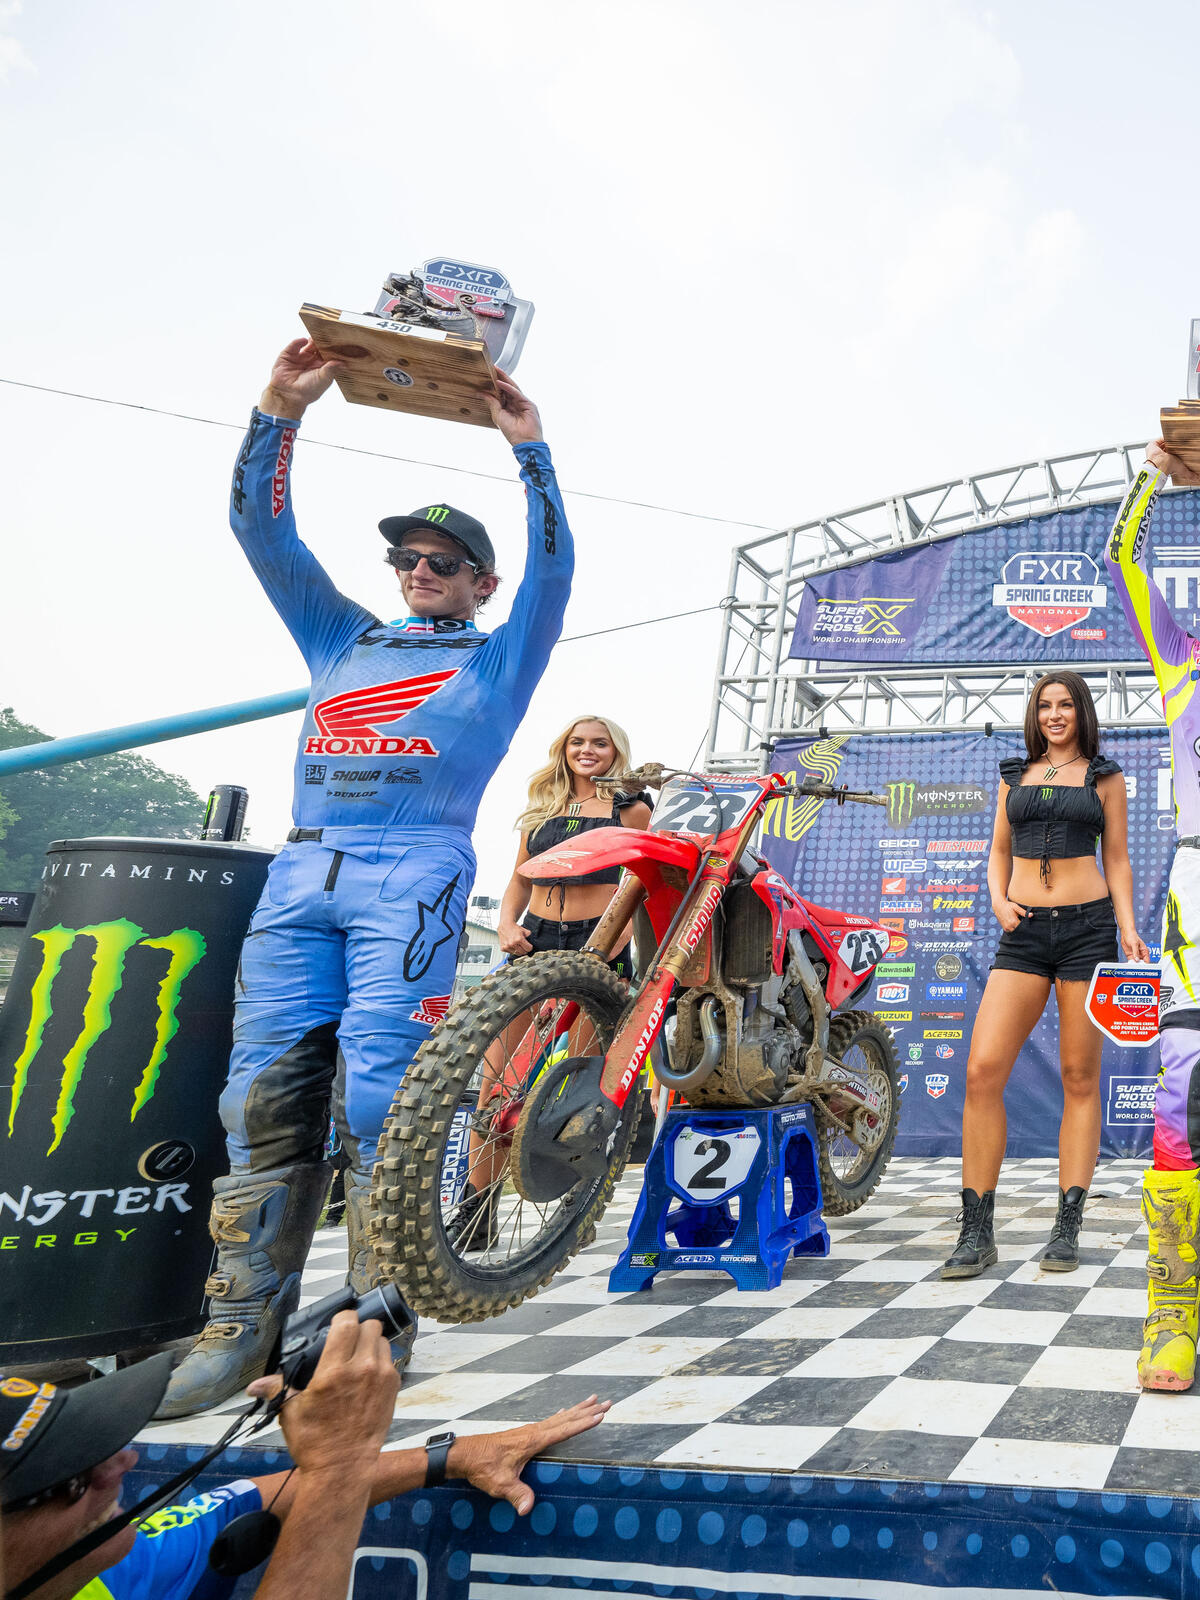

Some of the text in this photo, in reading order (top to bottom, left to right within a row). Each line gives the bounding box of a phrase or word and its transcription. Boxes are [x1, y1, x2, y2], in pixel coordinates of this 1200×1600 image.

[440, 263, 493, 284] FXR
[425, 275, 499, 297] SPRING CREEK
[376, 320, 412, 333] 450
[272, 428, 298, 518] HONDA
[1018, 559, 1083, 581] FXR
[1006, 588, 1094, 602] SPRING CREEK
[816, 605, 866, 615] SUPER
[1017, 607, 1081, 615] NATIONAL
[817, 614, 863, 624] MOTO
[813, 623, 863, 633] CROSS
[843, 636, 906, 644] CHAMPIONSHIP
[304, 737, 440, 757] HONDA
[330, 770, 382, 782] SHOWA
[333, 790, 378, 798] DUNLOP
[917, 790, 984, 802] MONSTER
[651, 790, 748, 834] 23
[879, 839, 919, 848] GEICO
[884, 859, 927, 873] WPS
[933, 860, 983, 869] FLY
[51, 862, 235, 886] VITAMINS
[941, 900, 974, 909] THOR
[685, 885, 724, 950] SHOWA
[844, 916, 872, 925] HONDA
[917, 920, 951, 928] Husqvarna
[847, 930, 884, 973] 23
[877, 965, 914, 973] Kawasaki
[880, 987, 907, 999] 100%
[1123, 985, 1148, 994] FXR
[412, 1014, 447, 1026] HON
[877, 1012, 910, 1020] SUZUKI
[620, 998, 665, 1091] DUNLOP
[1115, 1085, 1156, 1093] SUPER
[440, 1111, 467, 1206] MOTOCRO
[686, 1138, 732, 1189] 2
[0, 1182, 193, 1227] NSTER
[0, 1227, 138, 1250] ERGY
[675, 1255, 715, 1263] ACERBIS
